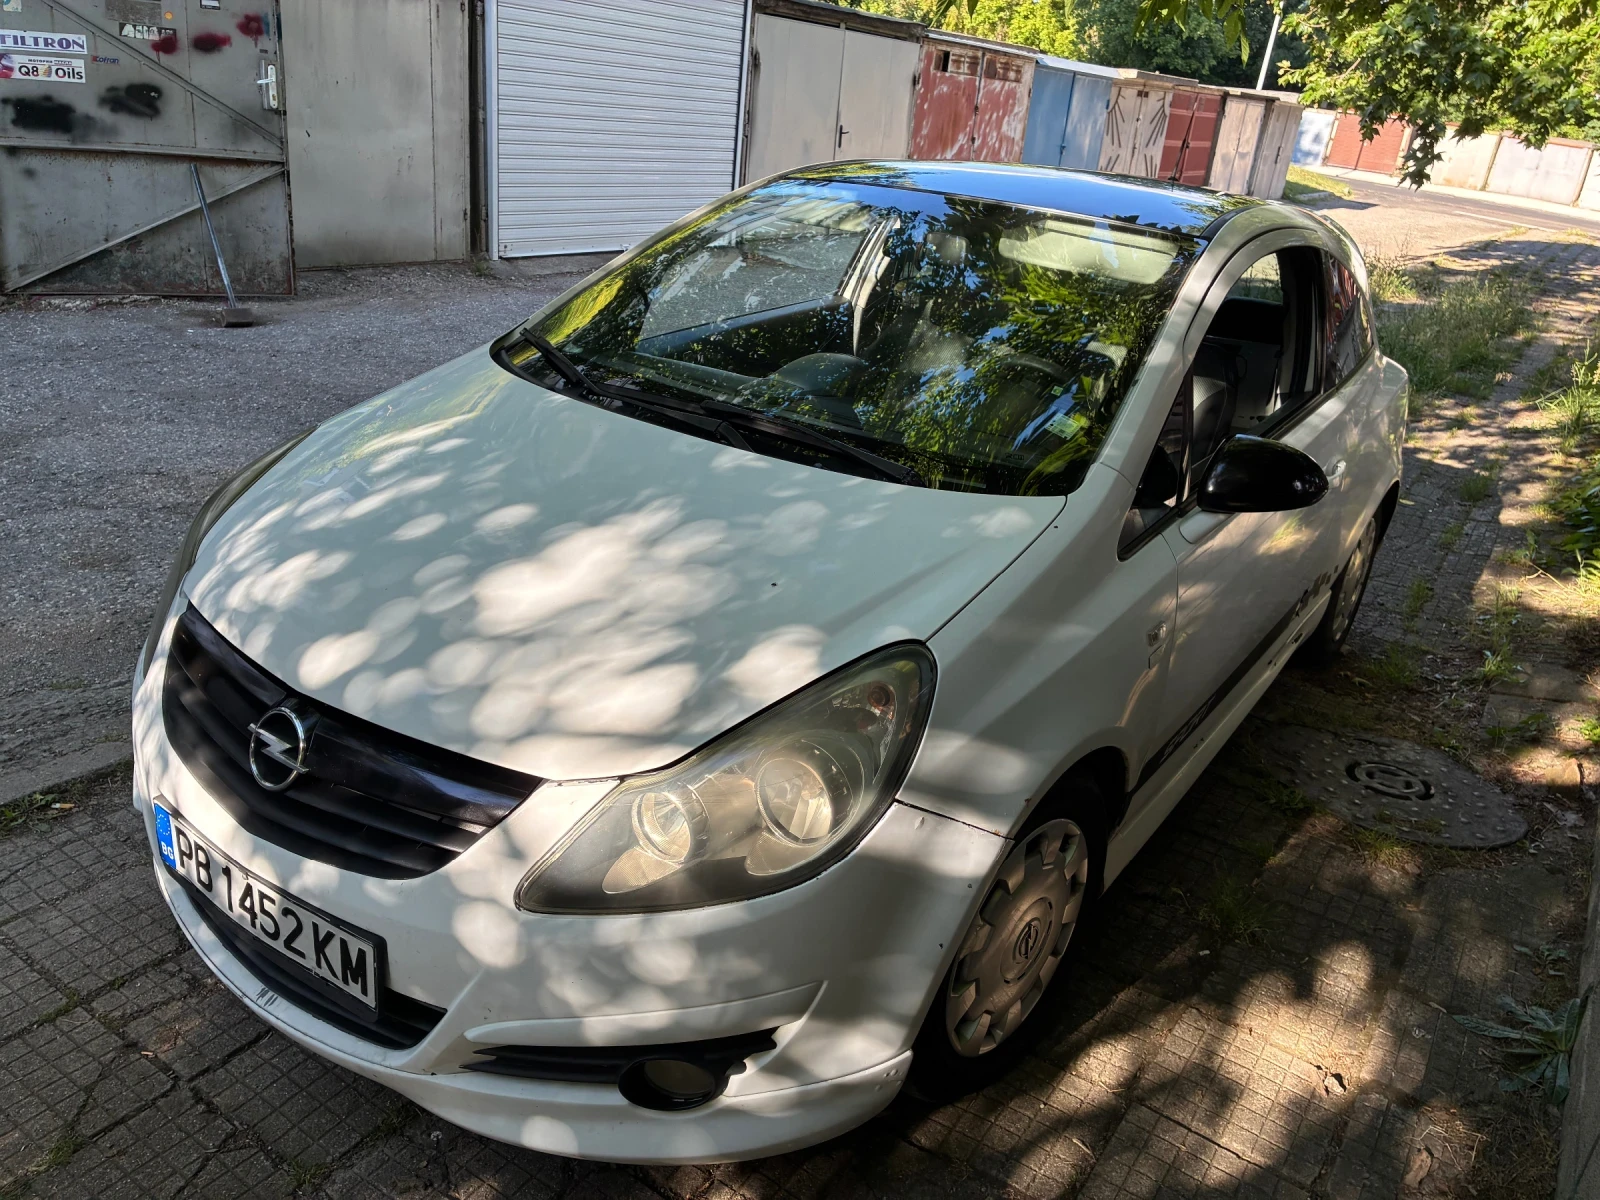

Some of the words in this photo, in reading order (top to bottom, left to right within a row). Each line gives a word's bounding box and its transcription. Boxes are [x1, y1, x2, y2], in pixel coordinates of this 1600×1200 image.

[0, 34, 85, 50] FILTRON
[18, 65, 39, 77] Q8
[55, 67, 83, 80] Oils
[160, 840, 174, 860] BG
[174, 826, 213, 893] PB
[221, 865, 306, 960] 1452
[311, 920, 368, 998] KM
